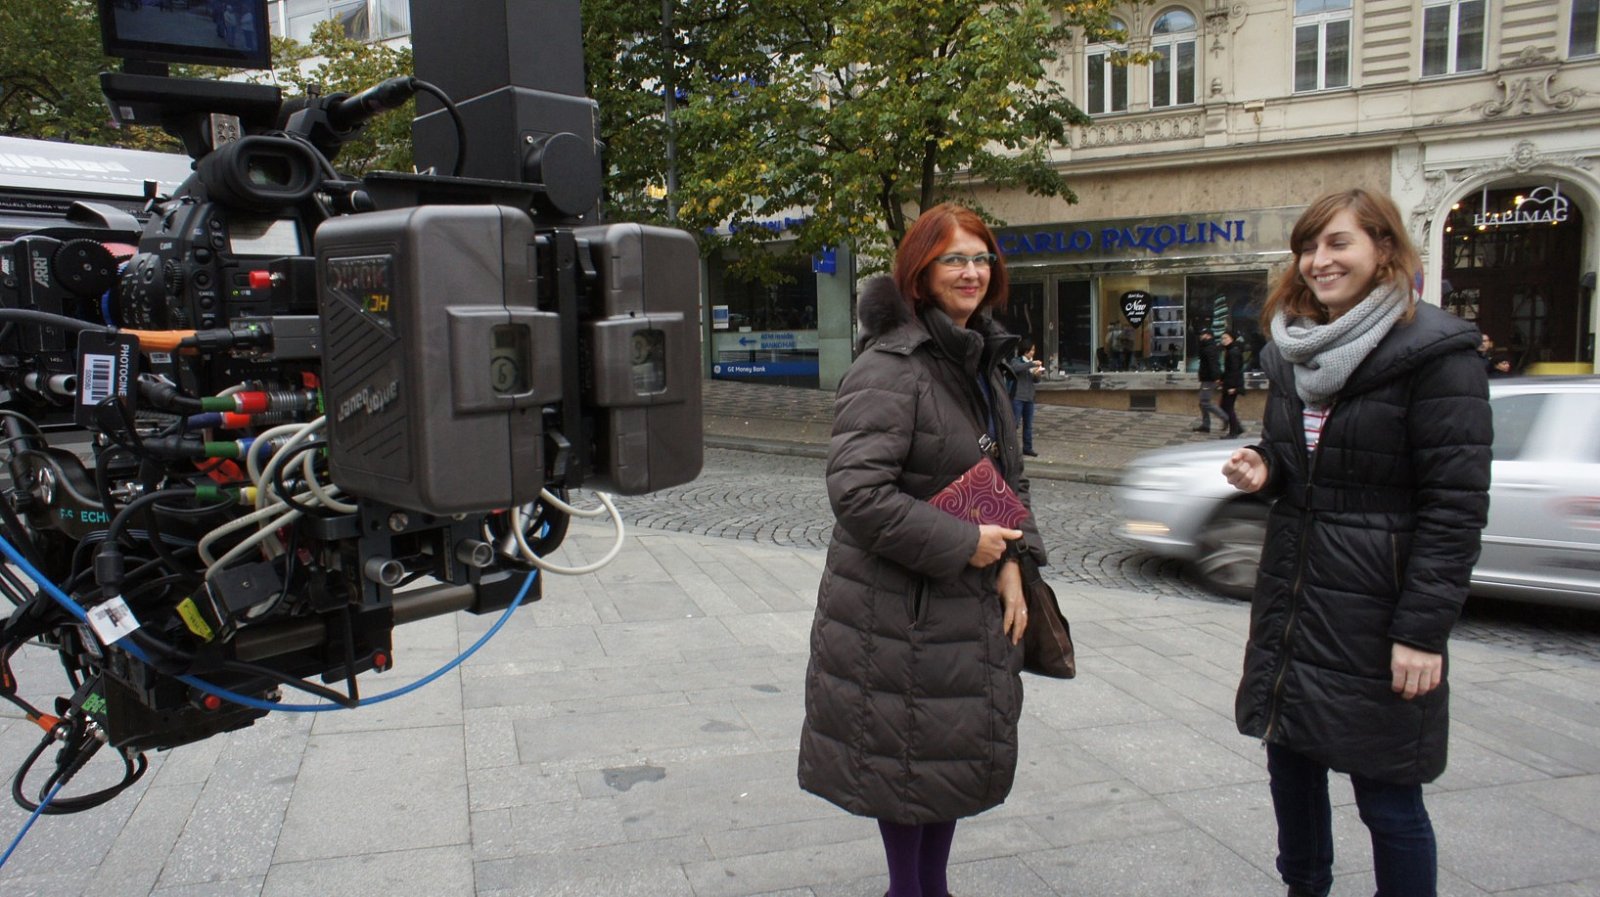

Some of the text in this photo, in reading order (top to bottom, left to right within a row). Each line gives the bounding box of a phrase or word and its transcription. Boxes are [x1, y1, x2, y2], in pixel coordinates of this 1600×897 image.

[1474, 207, 1568, 226] HAPIMAG
[997, 219, 1246, 255] CARLO PAZOLINI
[32, 257, 50, 289] ARRI
[118, 344, 130, 397] PHOTOCINE
[735, 366, 753, 374] Money
[80, 510, 110, 524] ECH
